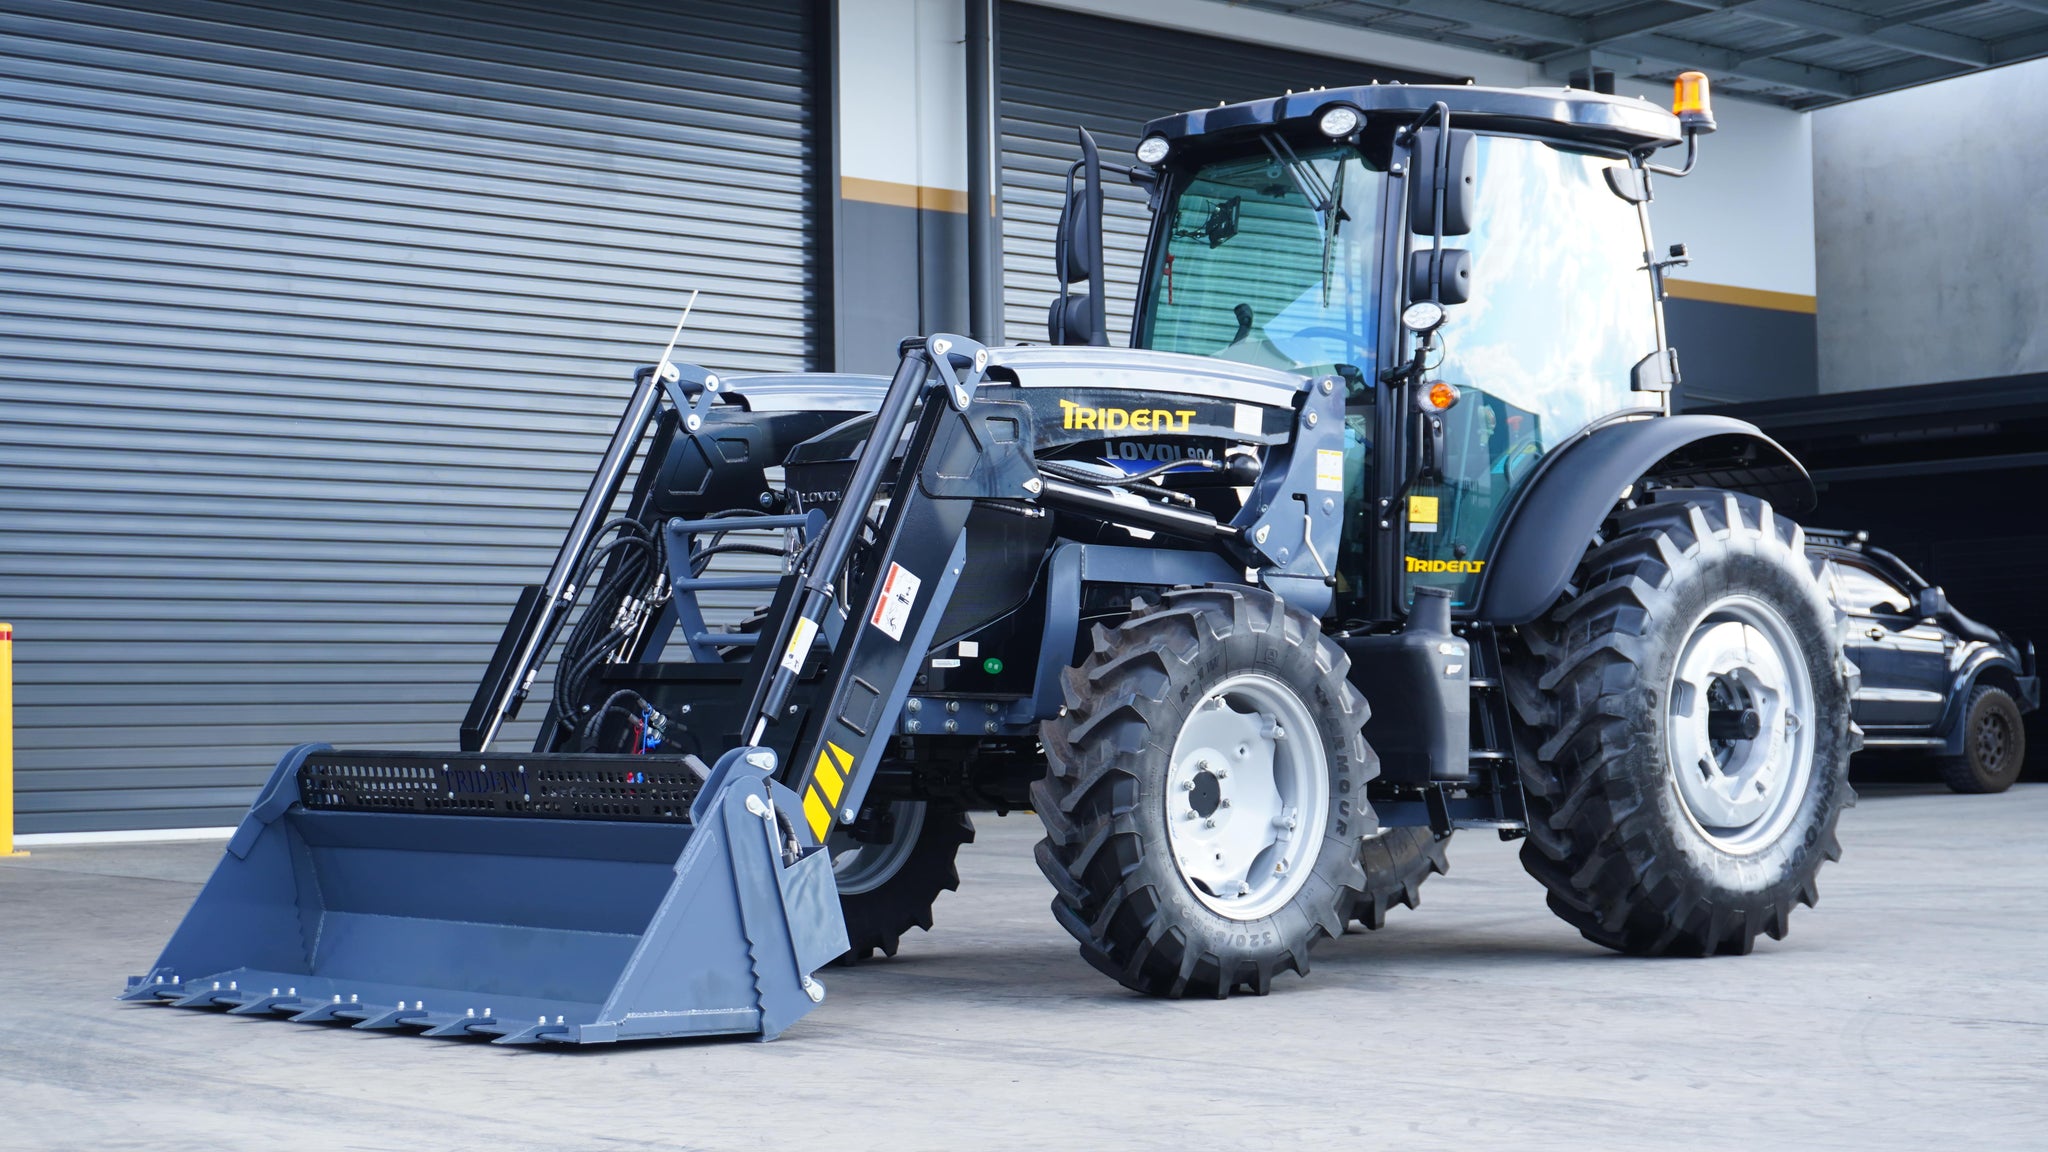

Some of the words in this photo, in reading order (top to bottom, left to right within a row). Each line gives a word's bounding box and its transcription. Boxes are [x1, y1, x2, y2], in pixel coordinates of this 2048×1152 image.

[1059, 398, 1197, 432] TRIDENT
[1405, 555, 1485, 573] TRIDENT
[441, 768, 531, 796] TRIDENT
